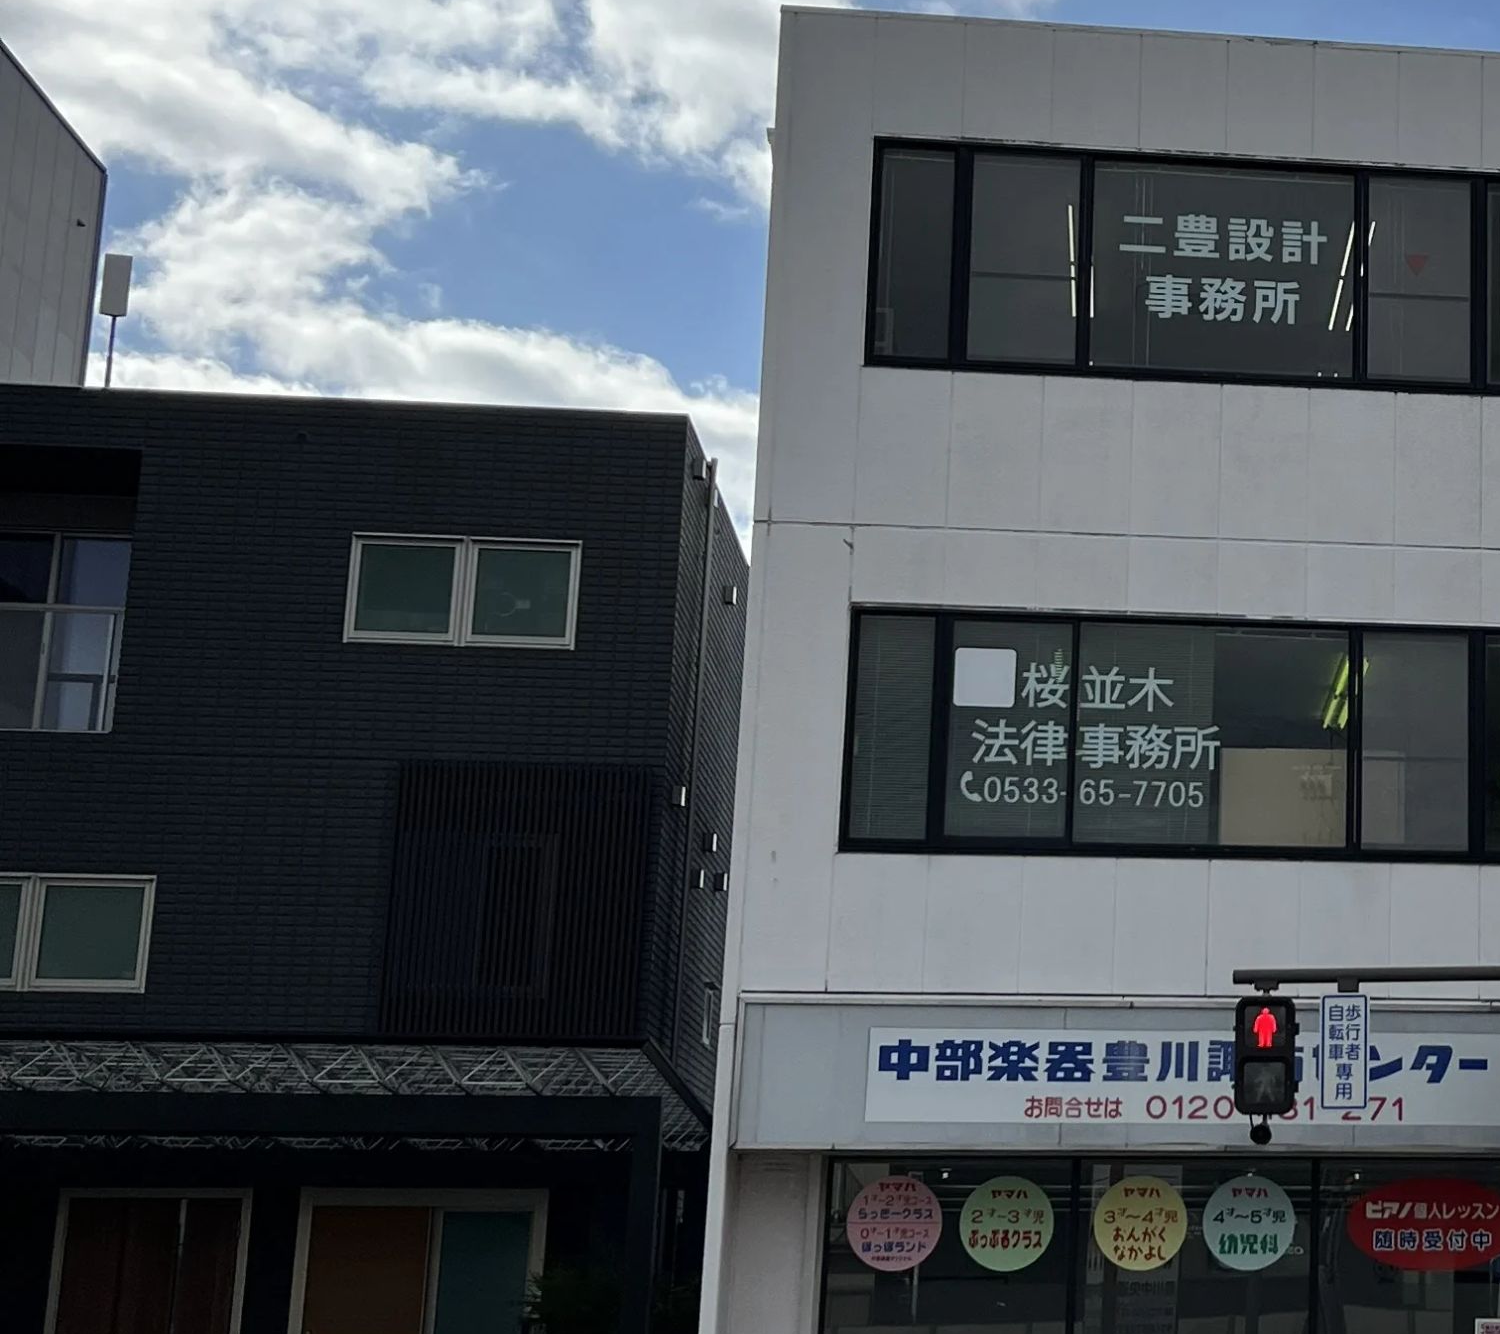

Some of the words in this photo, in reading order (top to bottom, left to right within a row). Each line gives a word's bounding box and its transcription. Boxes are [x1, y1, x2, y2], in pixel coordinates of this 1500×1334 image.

[1119, 214, 1328, 265] 二豊設計
[1144, 274, 1300, 325] 事務所
[1020, 662, 1175, 712] 桜並木
[971, 719, 1221, 770] 法律事務所
[1328, 1004, 1344, 1061] 自転車
[1345, 1004, 1361, 1061] 歩行者
[1335, 1063, 1353, 1101] 専用
[1024, 1096, 1123, 1121] お問合せは
[878, 1182, 917, 1192] ヤマハ
[991, 1189, 1028, 1199] ヤマハ
[1123, 1187, 1161, 1198] ヤマハ
[1232, 1187, 1269, 1198] ヤマハ
[1113, 1226, 1166, 1243] おんがく
[1219, 1233, 1280, 1255] 幼児科
[1373, 1228, 1492, 1251] 随時受付中
[1114, 1245, 1166, 1261] なかよし
